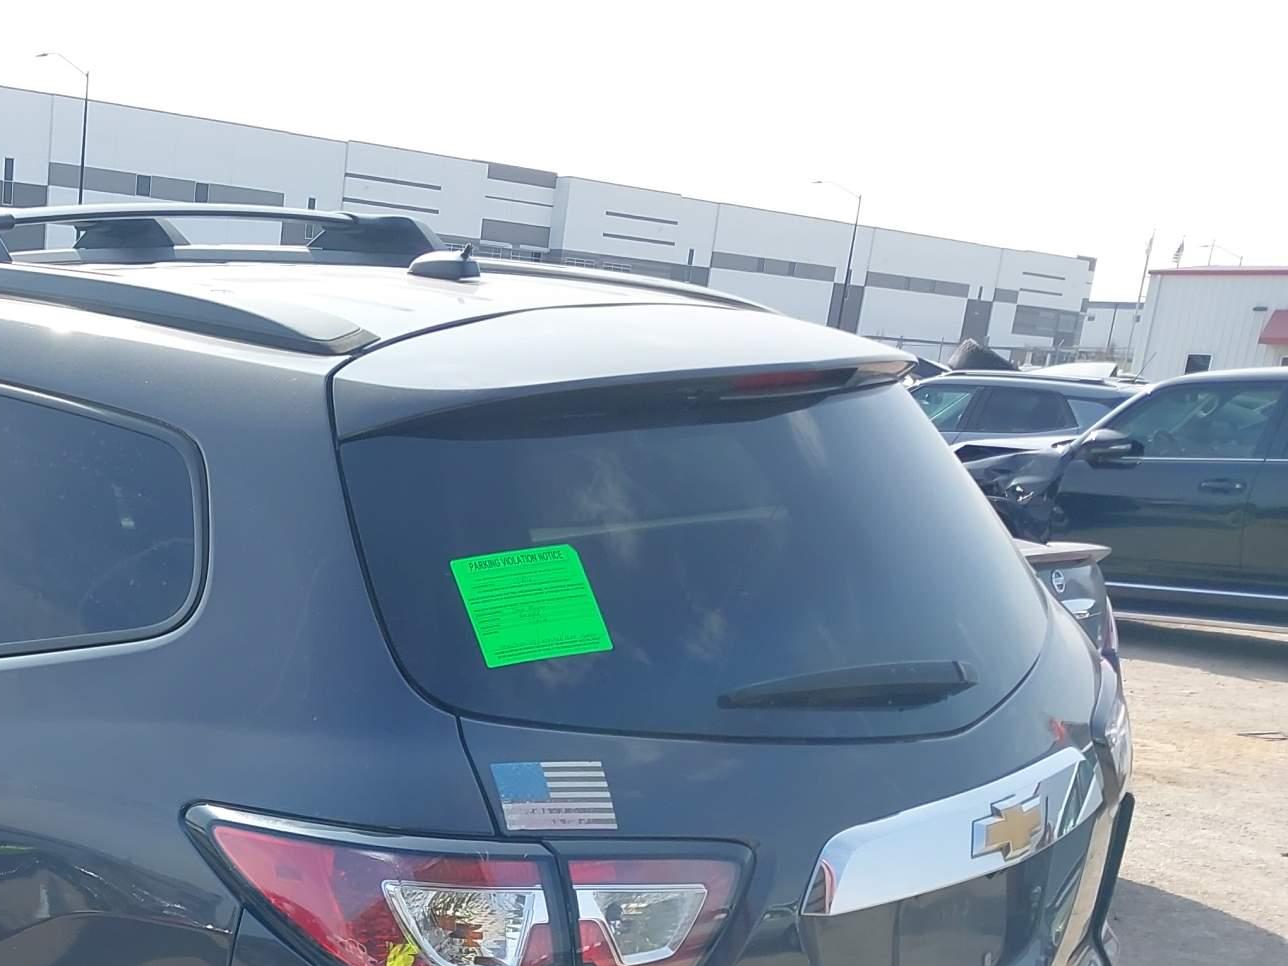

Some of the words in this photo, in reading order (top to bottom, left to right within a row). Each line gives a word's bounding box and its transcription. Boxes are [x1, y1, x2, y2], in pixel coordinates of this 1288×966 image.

[469, 558, 500, 571] PARKING
[501, 554, 537, 566] VIOLATION
[538, 550, 563, 562] NOTICE
